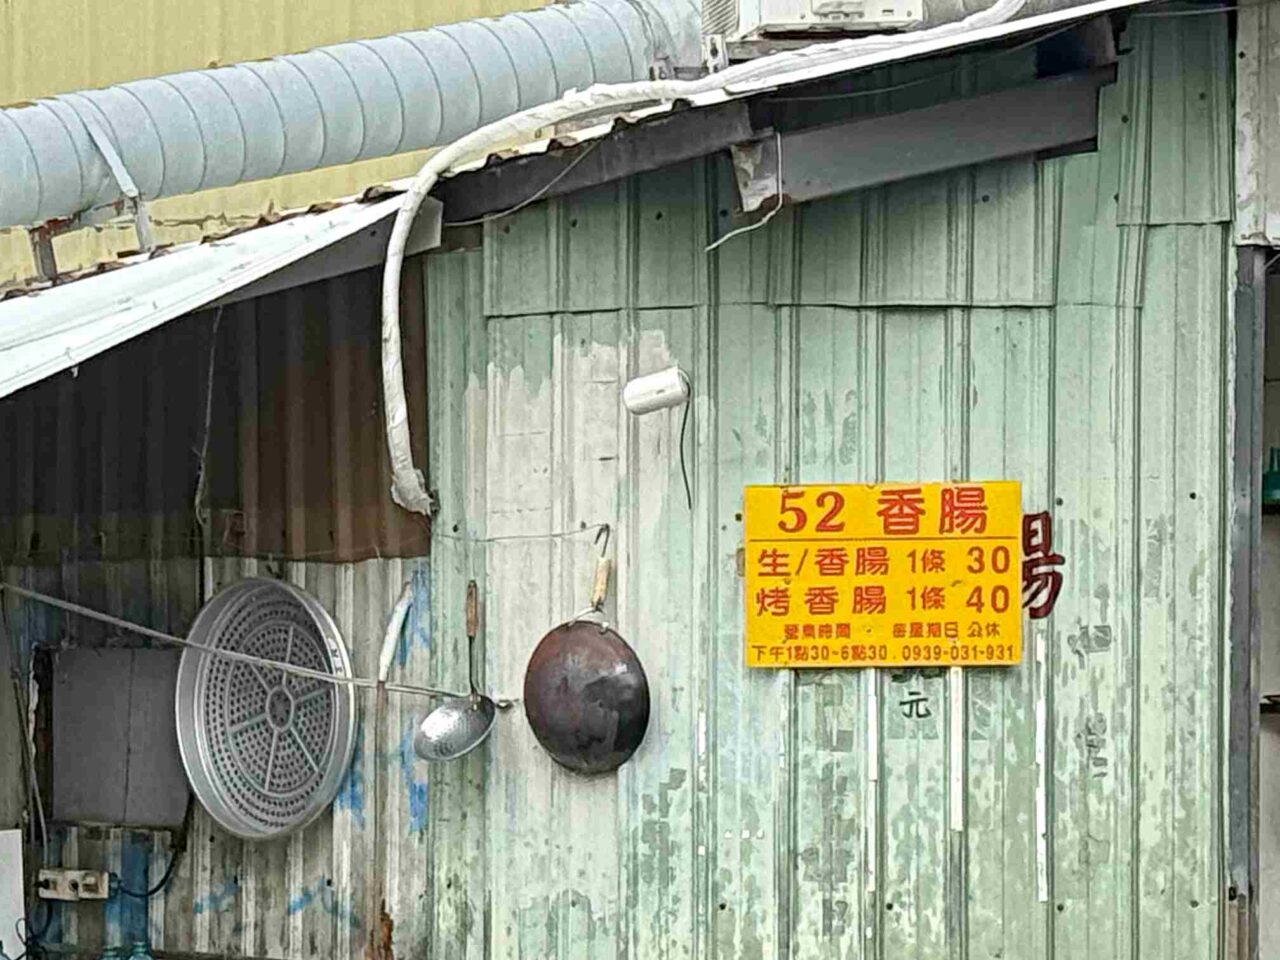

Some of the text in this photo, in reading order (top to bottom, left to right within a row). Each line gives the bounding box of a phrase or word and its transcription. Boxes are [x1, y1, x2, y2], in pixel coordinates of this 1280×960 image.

[778, 487, 989, 536] 52 香腸
[906, 548, 947, 575] 1條
[966, 545, 1010, 574] 30
[755, 584, 1010, 617] 烤香腸 1條 40
[966, 621, 1001, 639] 公休
[899, 691, 932, 718] 元
